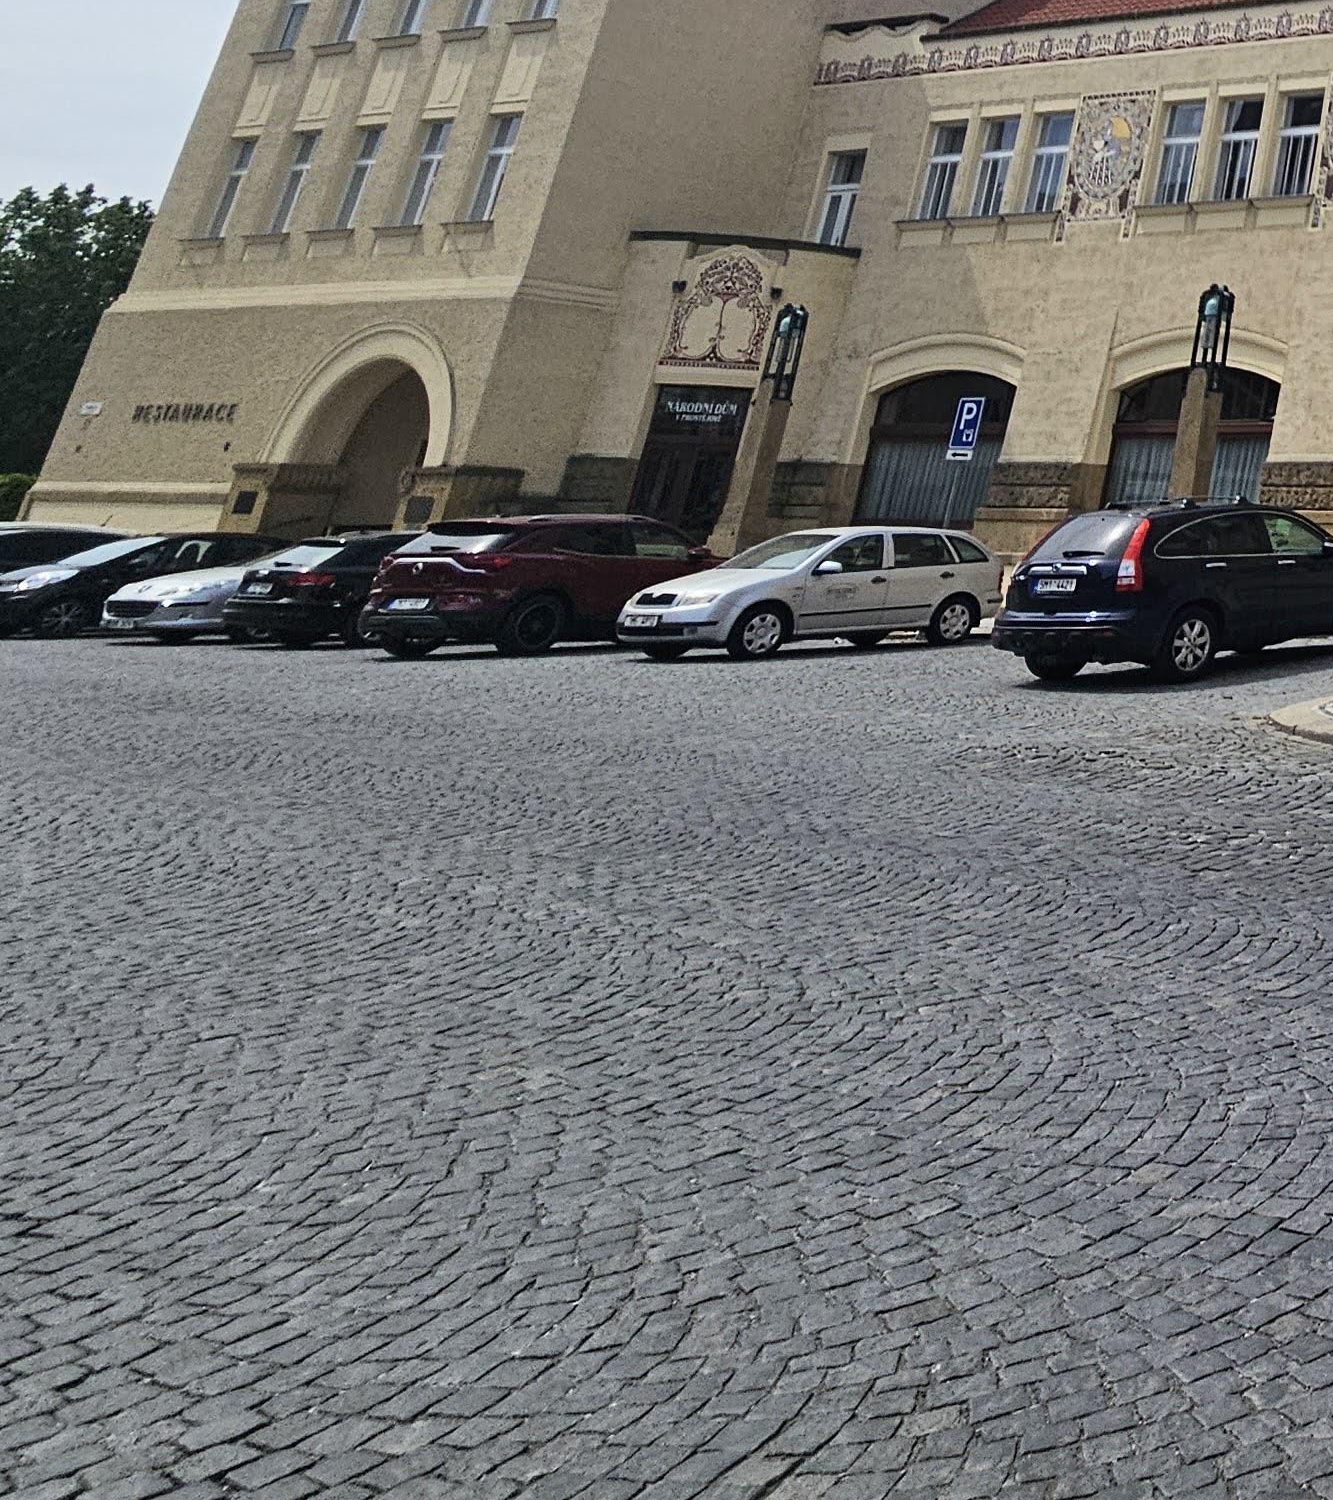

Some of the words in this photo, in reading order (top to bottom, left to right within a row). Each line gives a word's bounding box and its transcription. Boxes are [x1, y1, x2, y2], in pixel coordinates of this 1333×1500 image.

[132, 403, 239, 424] RESTAURACE
[665, 399, 714, 414] NÁRODNÍ
[959, 402, 977, 430] P
